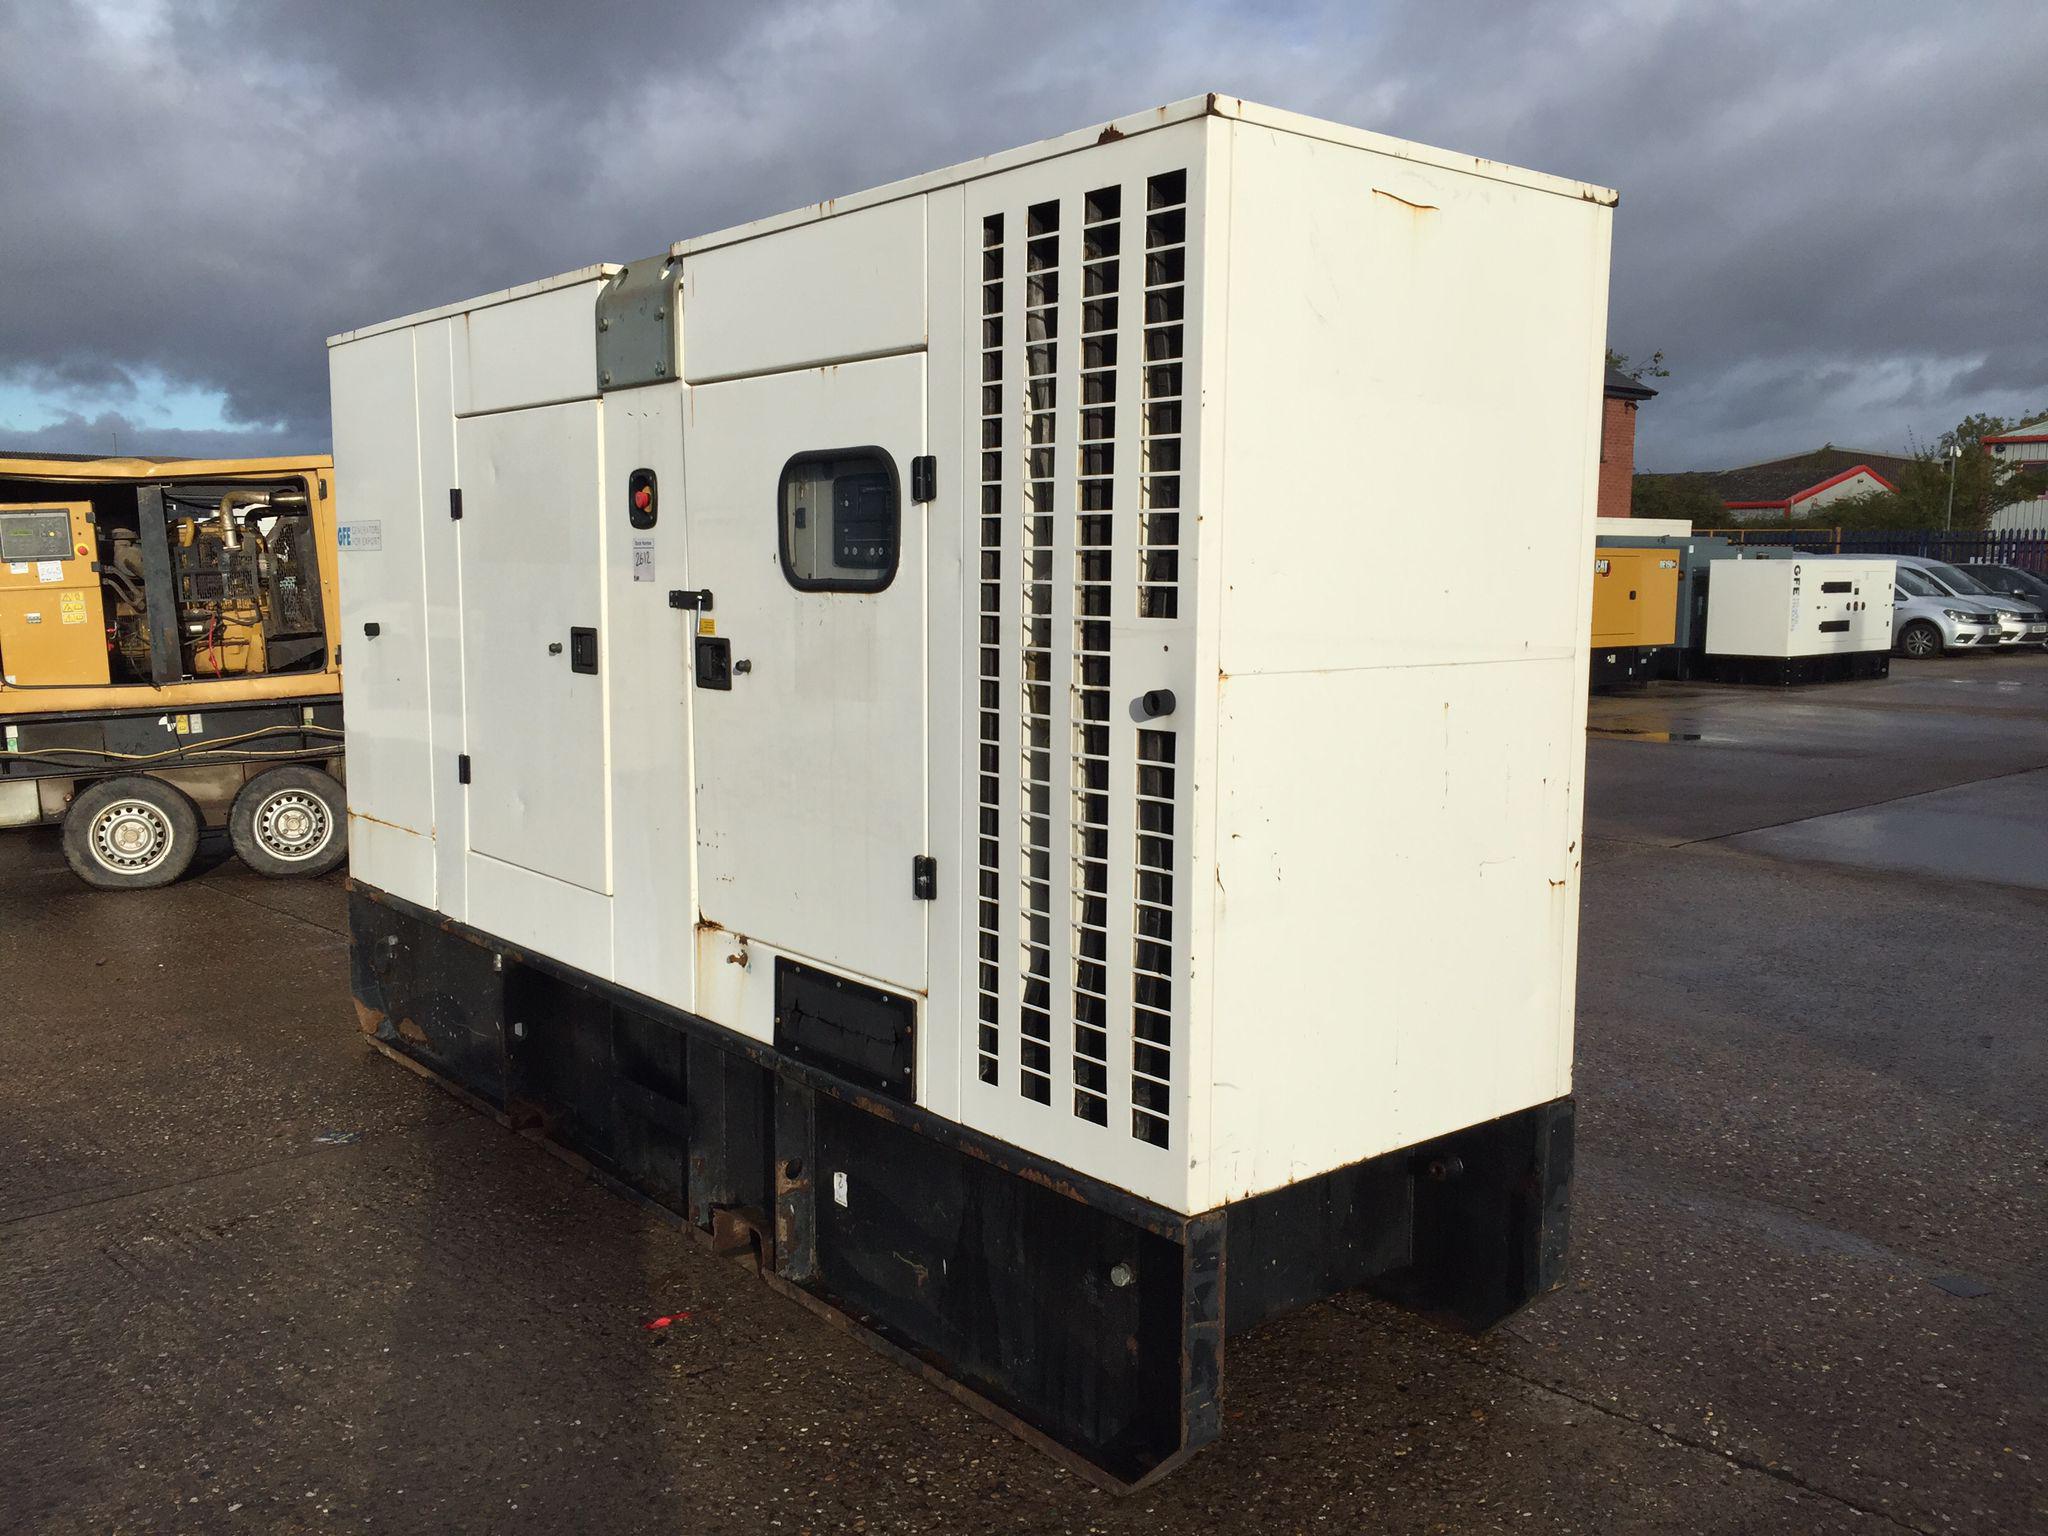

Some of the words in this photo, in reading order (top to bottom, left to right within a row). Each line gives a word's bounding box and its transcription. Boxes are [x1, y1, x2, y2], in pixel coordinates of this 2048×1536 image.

[338, 527, 351, 546] GFE
[1595, 560, 1609, 573] CAT
[1793, 564, 1801, 596] GFE
